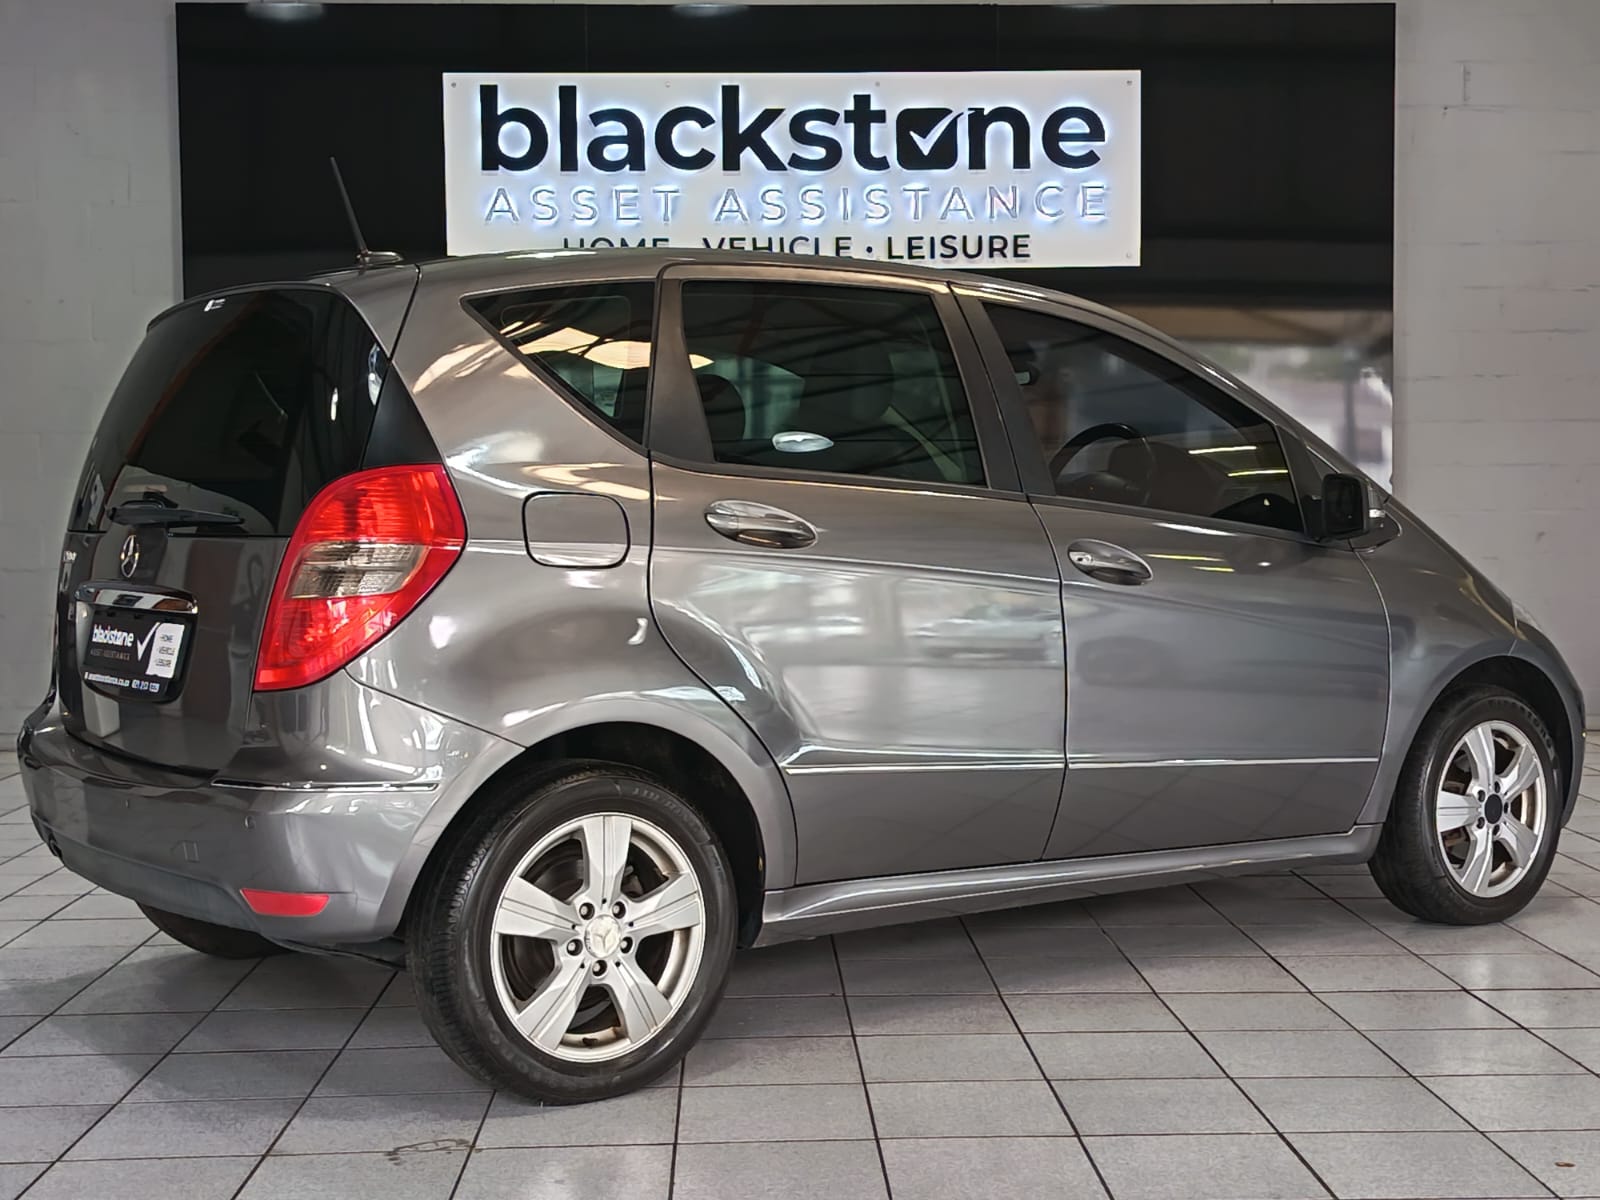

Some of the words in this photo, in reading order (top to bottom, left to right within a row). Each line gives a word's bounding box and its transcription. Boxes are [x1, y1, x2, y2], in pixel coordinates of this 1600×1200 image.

[479, 84, 1107, 172] blackstone
[484, 187, 680, 222] ASSET
[714, 185, 1107, 222] ASSISTANCE
[887, 234, 1031, 259] LEISURE
